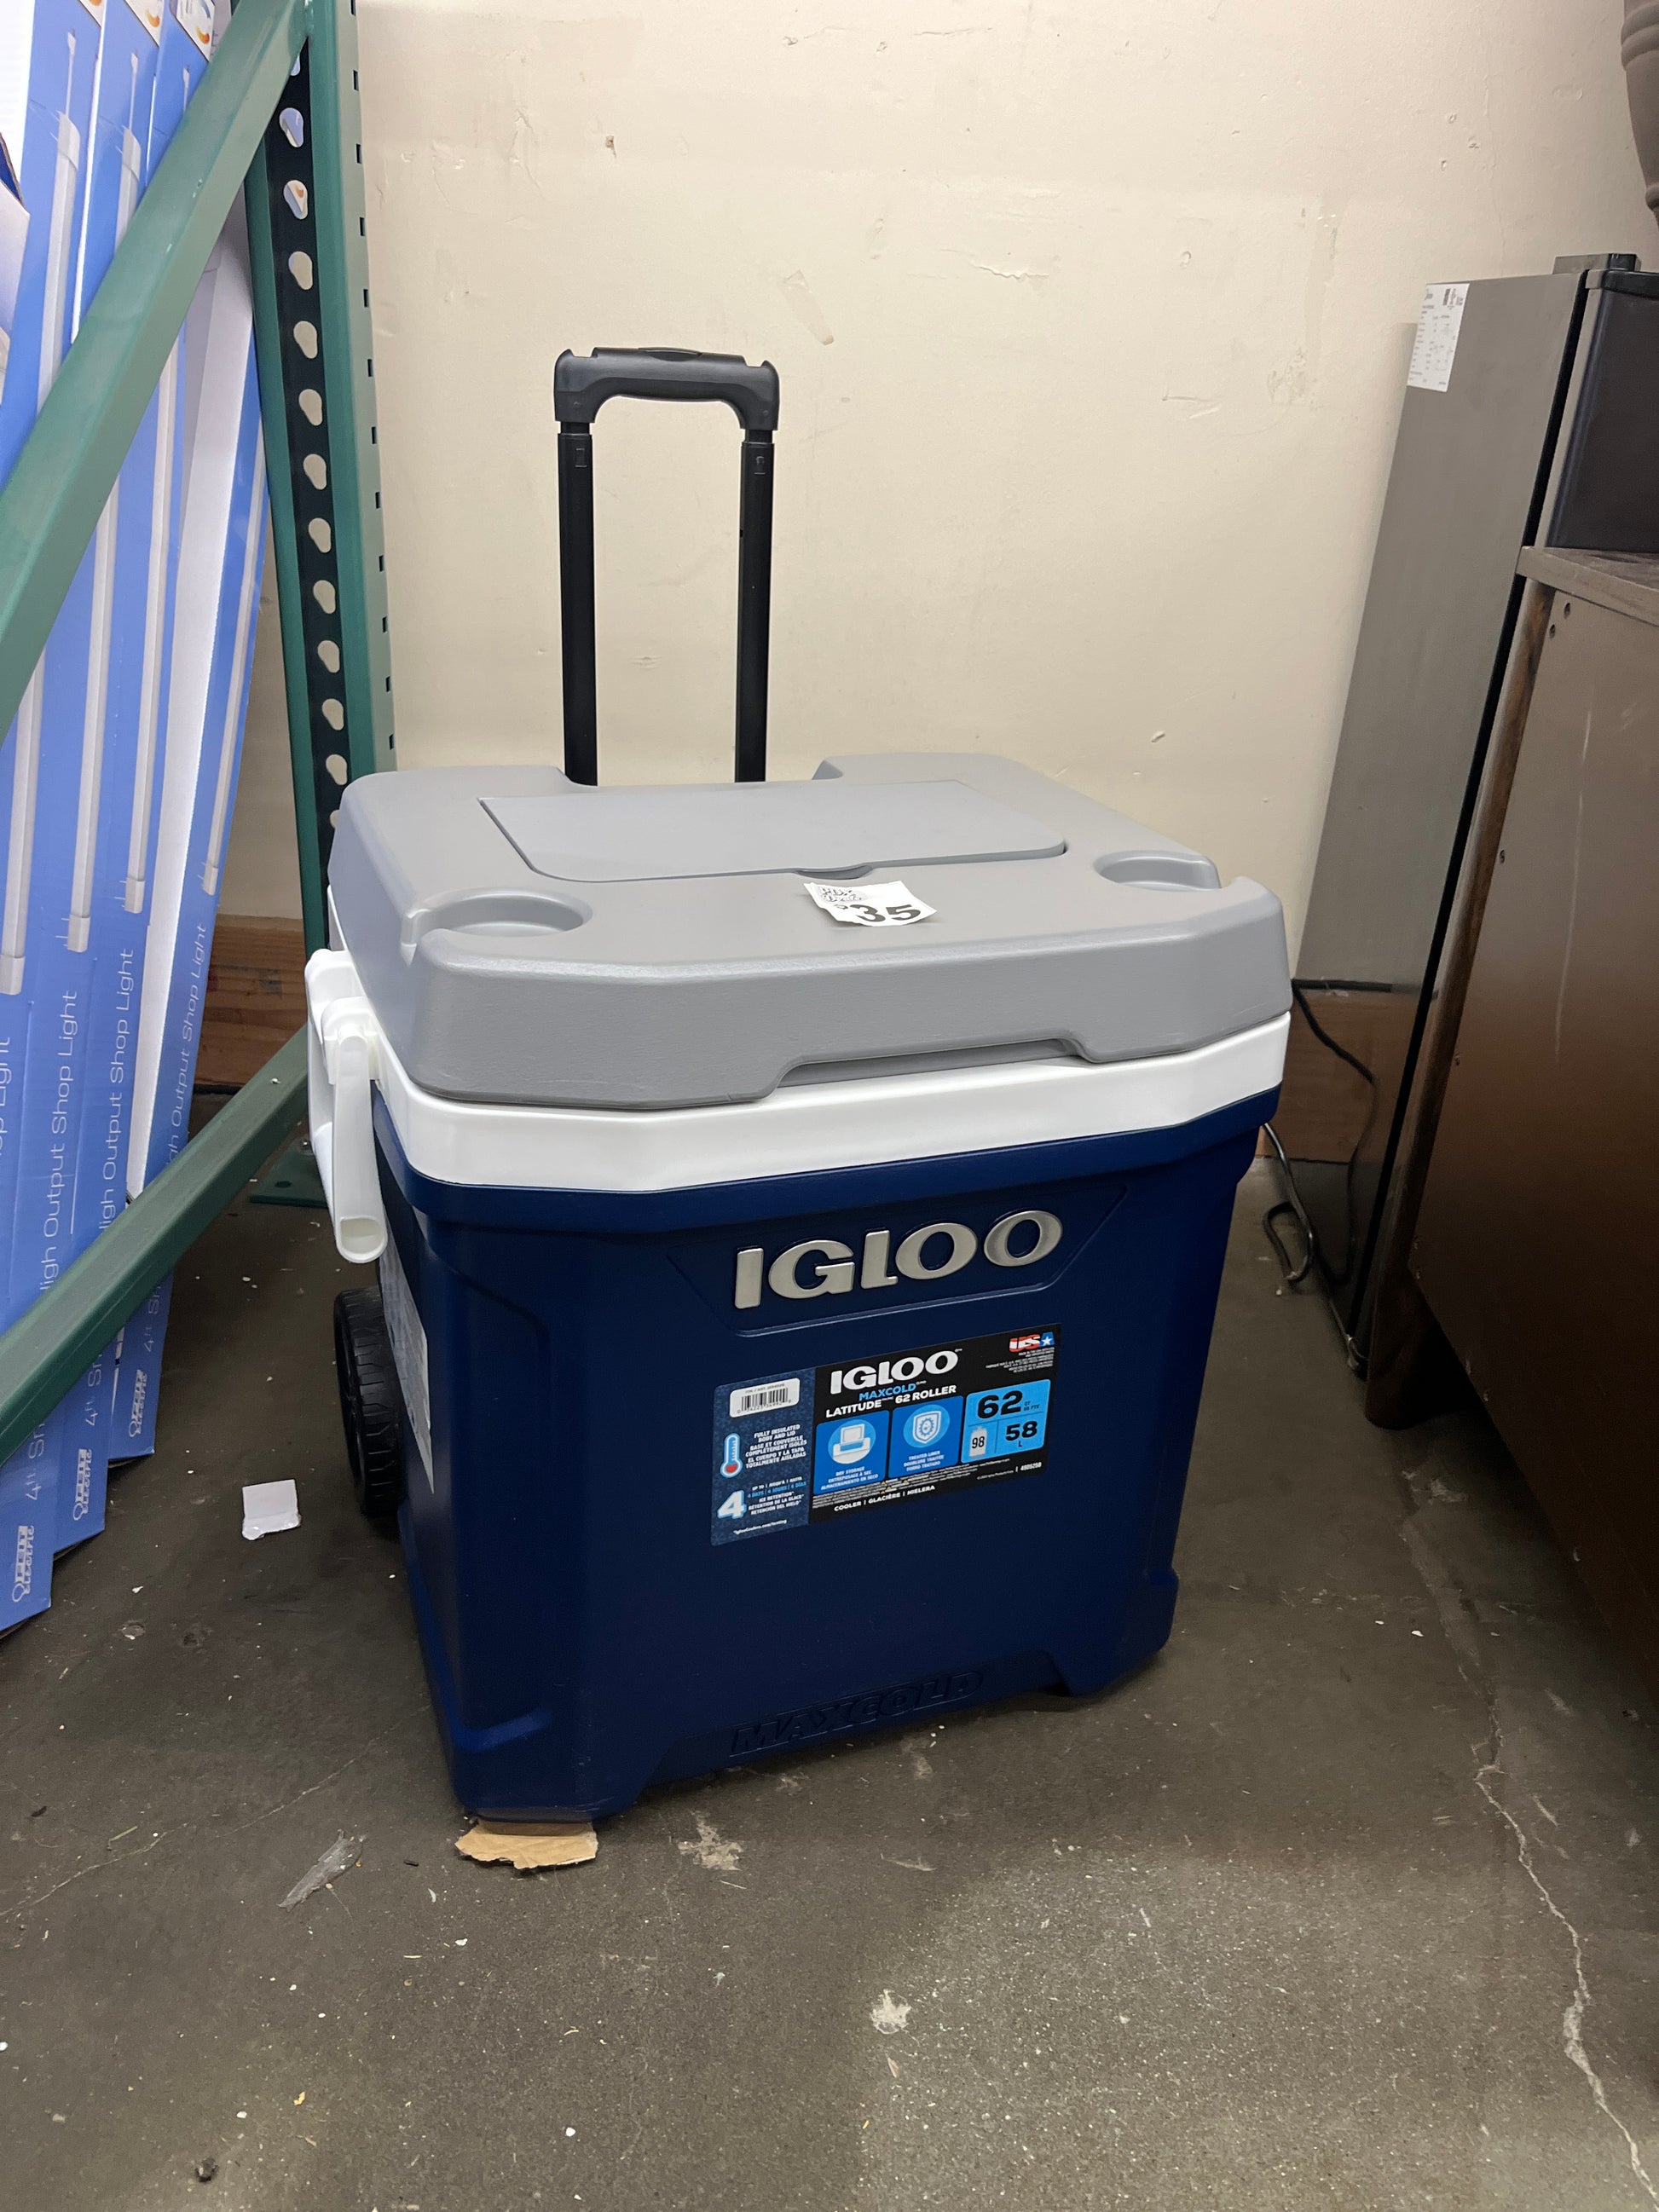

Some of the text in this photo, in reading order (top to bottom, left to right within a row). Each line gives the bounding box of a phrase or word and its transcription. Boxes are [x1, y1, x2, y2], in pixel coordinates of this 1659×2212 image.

[190, 922, 207, 978] Light
[117, 948, 134, 1010] Light
[58, 990, 78, 1057] Light
[182, 985, 199, 1042] Shop
[109, 1019, 129, 1083] Shop
[51, 1063, 73, 1135] Shop
[171, 1048, 190, 1127] Output
[101, 1092, 122, 1181] Output
[43, 1142, 65, 1237] Output
[734, 1210, 1063, 1308] IGLOO
[1009, 1331, 1055, 1353] USA
[830, 1350, 958, 1395] IGLOO
[858, 1383, 916, 1401] MAXCOLD
[825, 1384, 957, 1418] LATITUDE 62 ROLLER
[977, 1390, 1023, 1419] 62
[754, 1424, 801, 1439] FULLY INSULATED
[773, 1435, 803, 1447] COUVERCLE
[971, 1435, 986, 1449] 98
[1005, 1421, 1038, 1441] 58
[745, 1451, 806, 1469] TOTALMENTE AISLADAS
[755, 1453, 777, 1461] CUERPO
[717, 1490, 747, 1519] 4
[834, 1500, 862, 1512] COOLER
[906, 1484, 935, 1496] HIELERA
[731, 1672, 984, 1756] MAXCOLD
